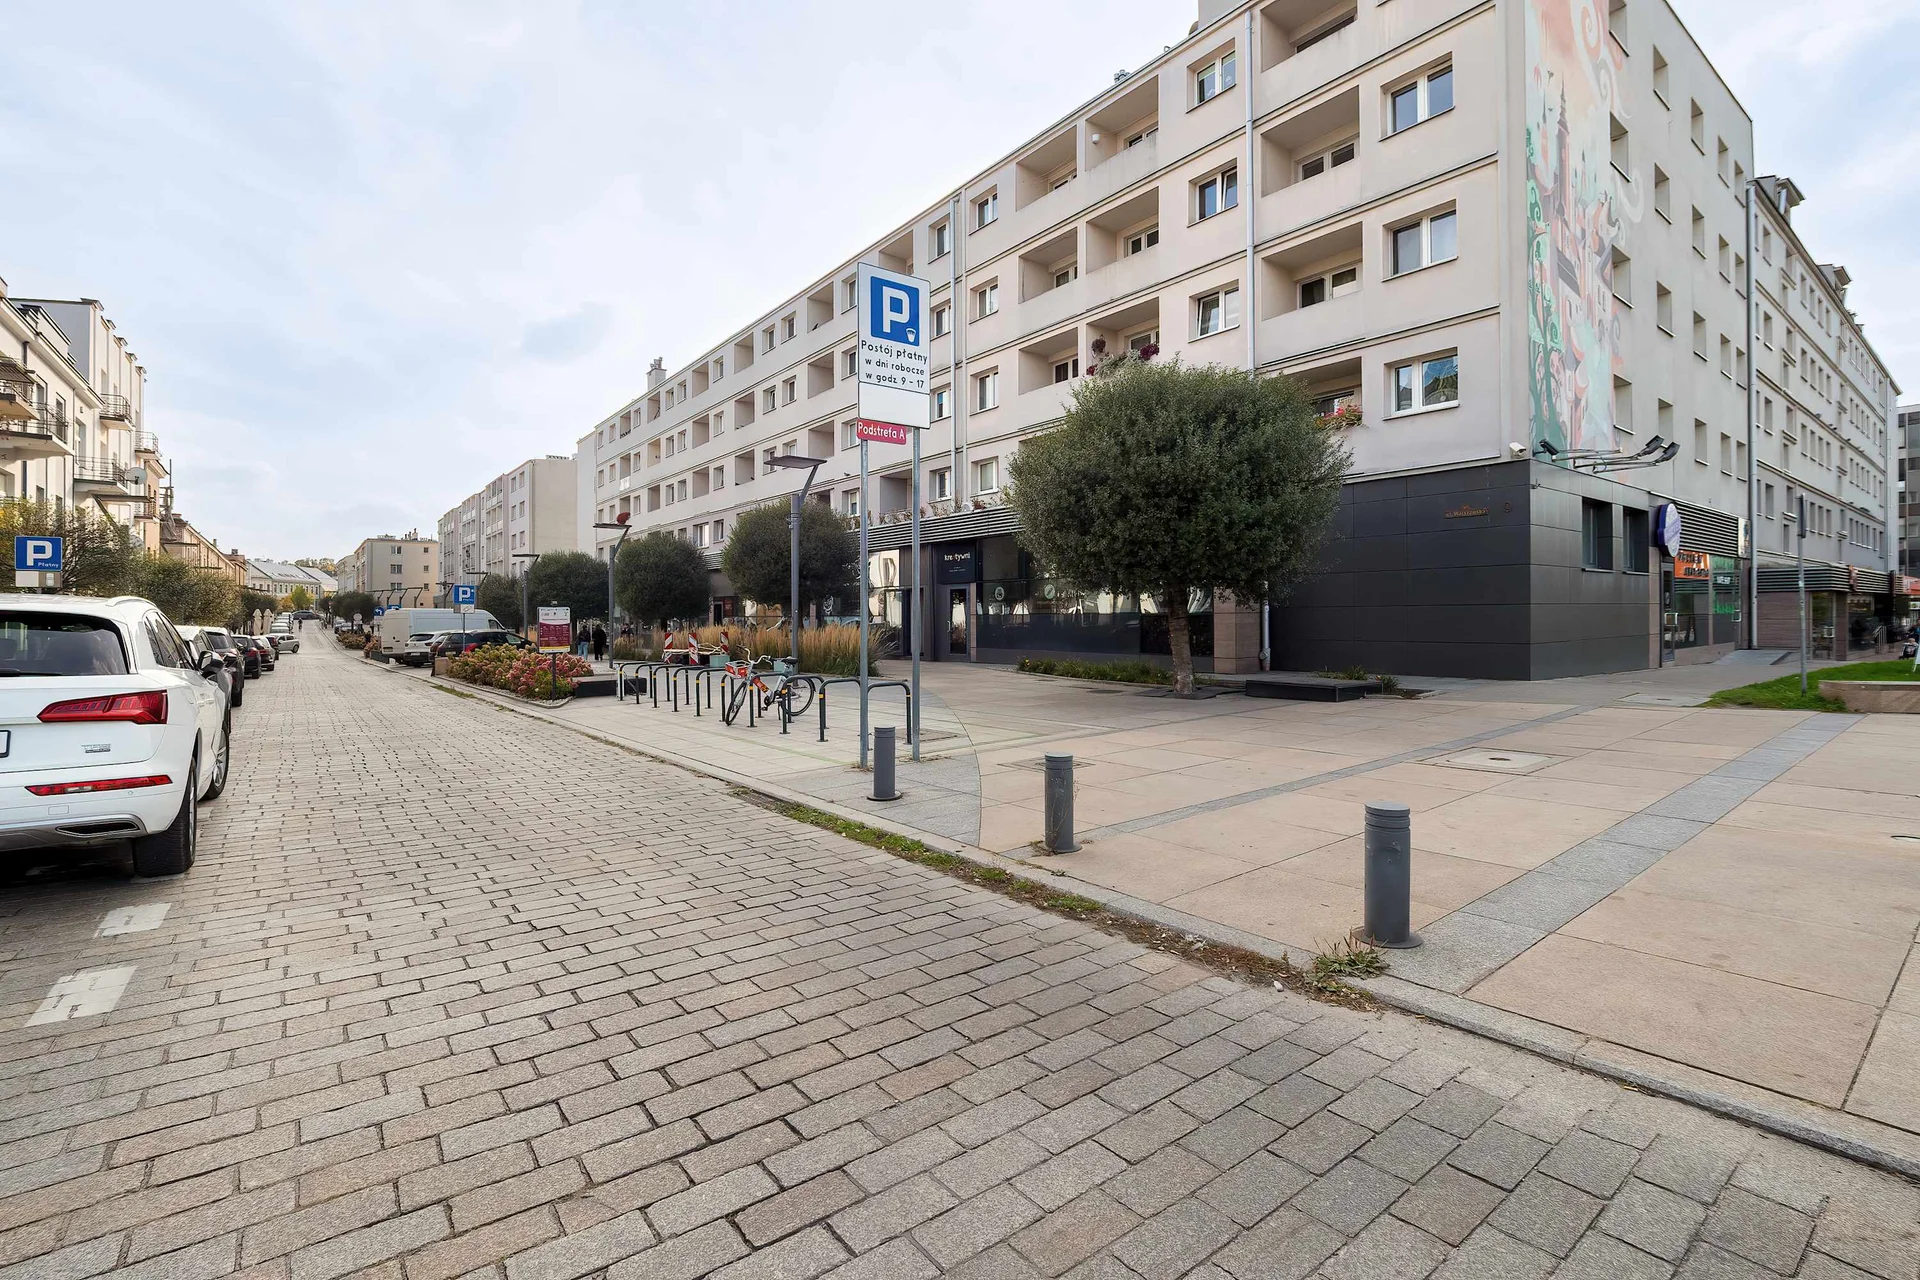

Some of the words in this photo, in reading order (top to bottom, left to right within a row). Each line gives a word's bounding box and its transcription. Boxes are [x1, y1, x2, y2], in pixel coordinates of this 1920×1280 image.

[883, 286, 910, 333] P
[861, 339, 893, 358] Postój
[896, 347, 928, 365] płatny
[875, 358, 889, 368] dni
[891, 363, 925, 375] robocze
[865, 372, 873, 380] w
[901, 376, 907, 386] 9
[916, 379, 925, 389] 17
[858, 422, 897, 439] Podstrefa
[899, 428, 905, 440] A
[26, 540, 52, 566] P
[459, 587, 470, 601] P
